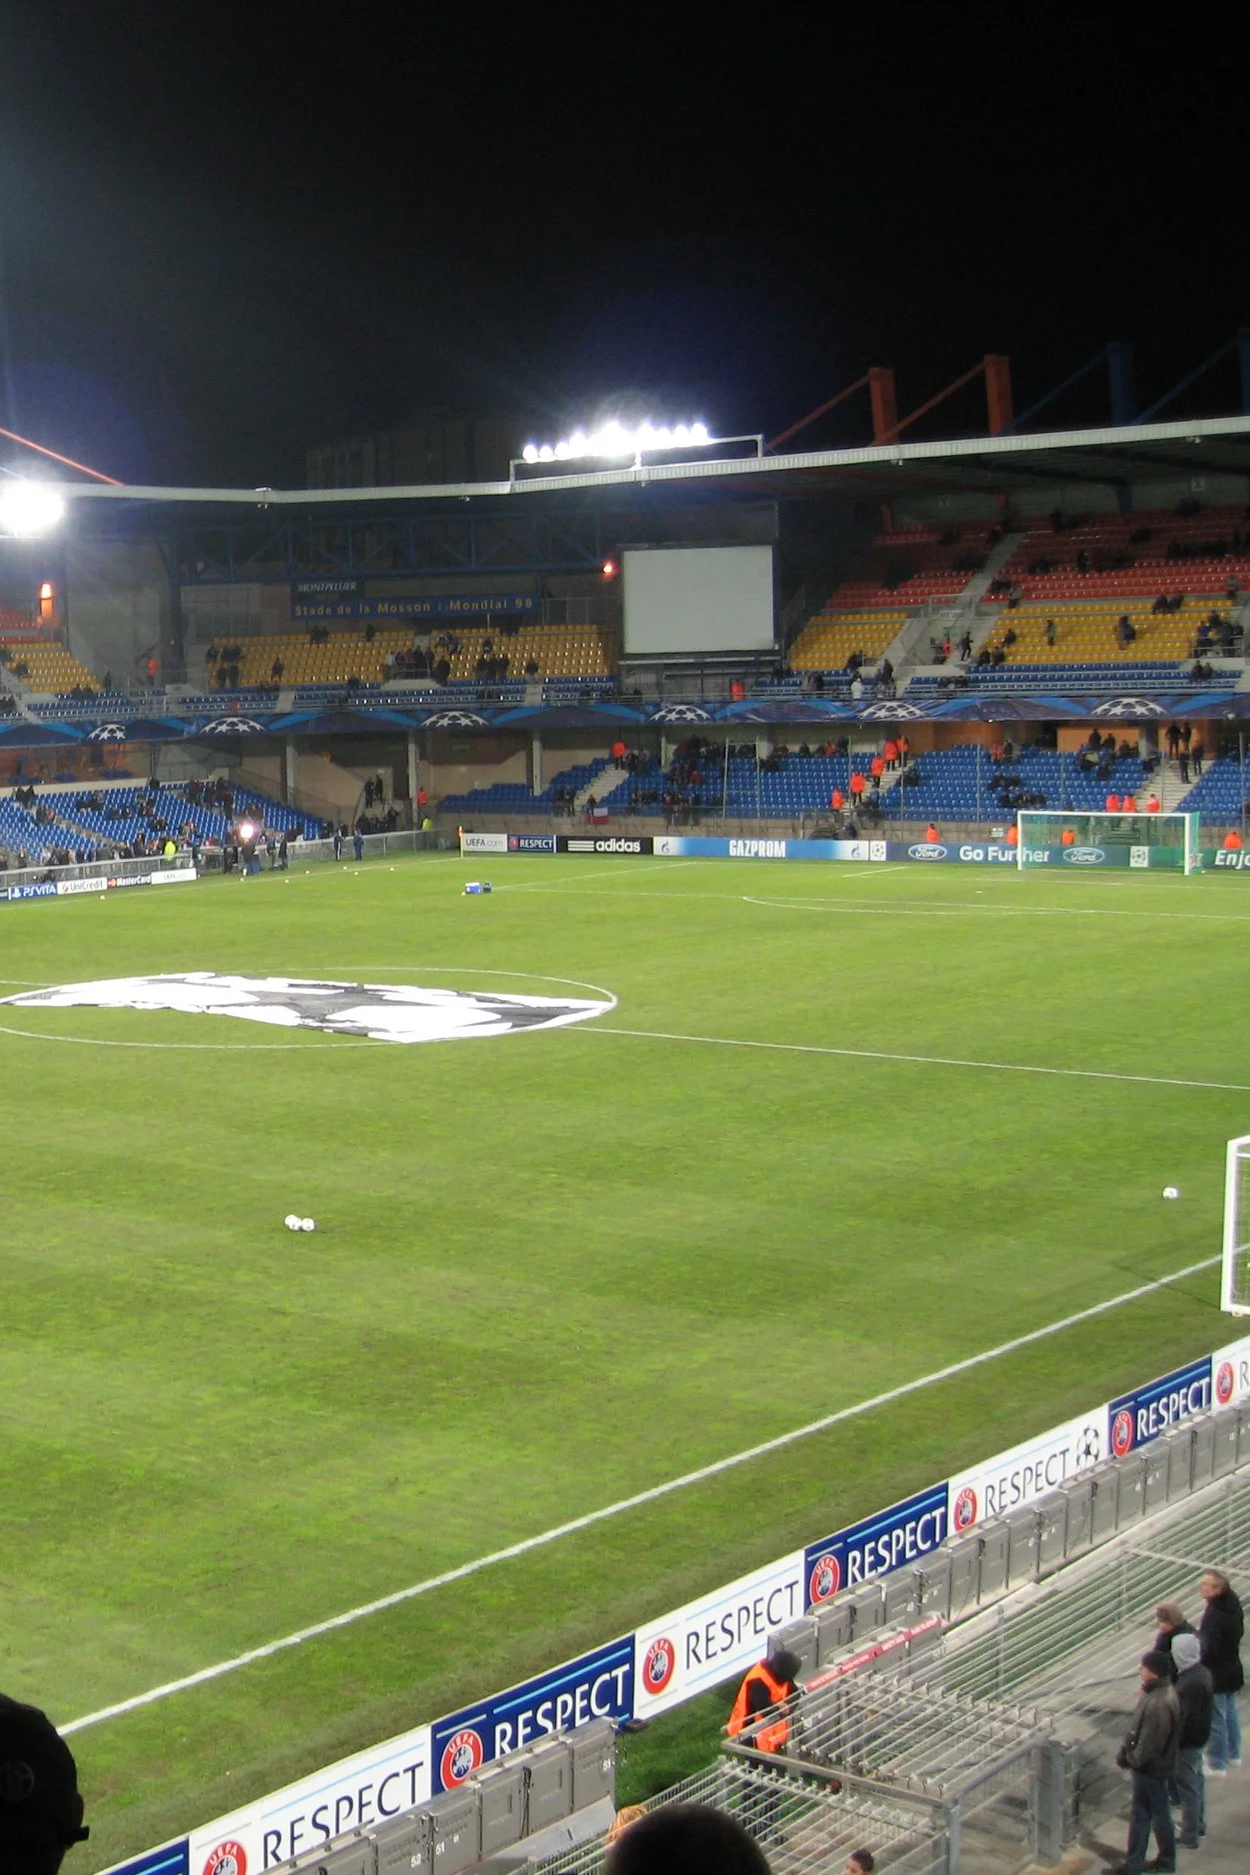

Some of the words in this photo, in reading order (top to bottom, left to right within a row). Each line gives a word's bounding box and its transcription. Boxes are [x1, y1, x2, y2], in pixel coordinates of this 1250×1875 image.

[294, 605, 332, 617] Stade
[337, 605, 352, 615] de
[359, 603, 370, 614] la
[377, 602, 431, 613] Mosson
[450, 599, 508, 611] Mondial
[515, 598, 533, 609] 98
[465, 837, 503, 848] UEFA.com
[519, 838, 553, 849] RESPECT
[595, 838, 641, 853] adidas
[729, 839, 786, 858] GAZPROM
[915, 846, 940, 859] Ford
[959, 845, 984, 861] Go
[1070, 850, 1097, 862] Ford
[70, 879, 104, 892] UniCredit
[116, 873, 151, 887] MasterCard
[1136, 1376, 1211, 1441] RESPECT
[984, 1447, 1071, 1518] RESPECT
[847, 1506, 946, 1588] RESPECT
[685, 1579, 800, 1670] RESPECT
[647, 1638, 671, 1659] UEFA
[494, 1663, 630, 1760] RESPECT
[447, 1733, 476, 1754] UEFA
[262, 1761, 424, 1870] RESPECT
[209, 1843, 239, 1866] UEFA
